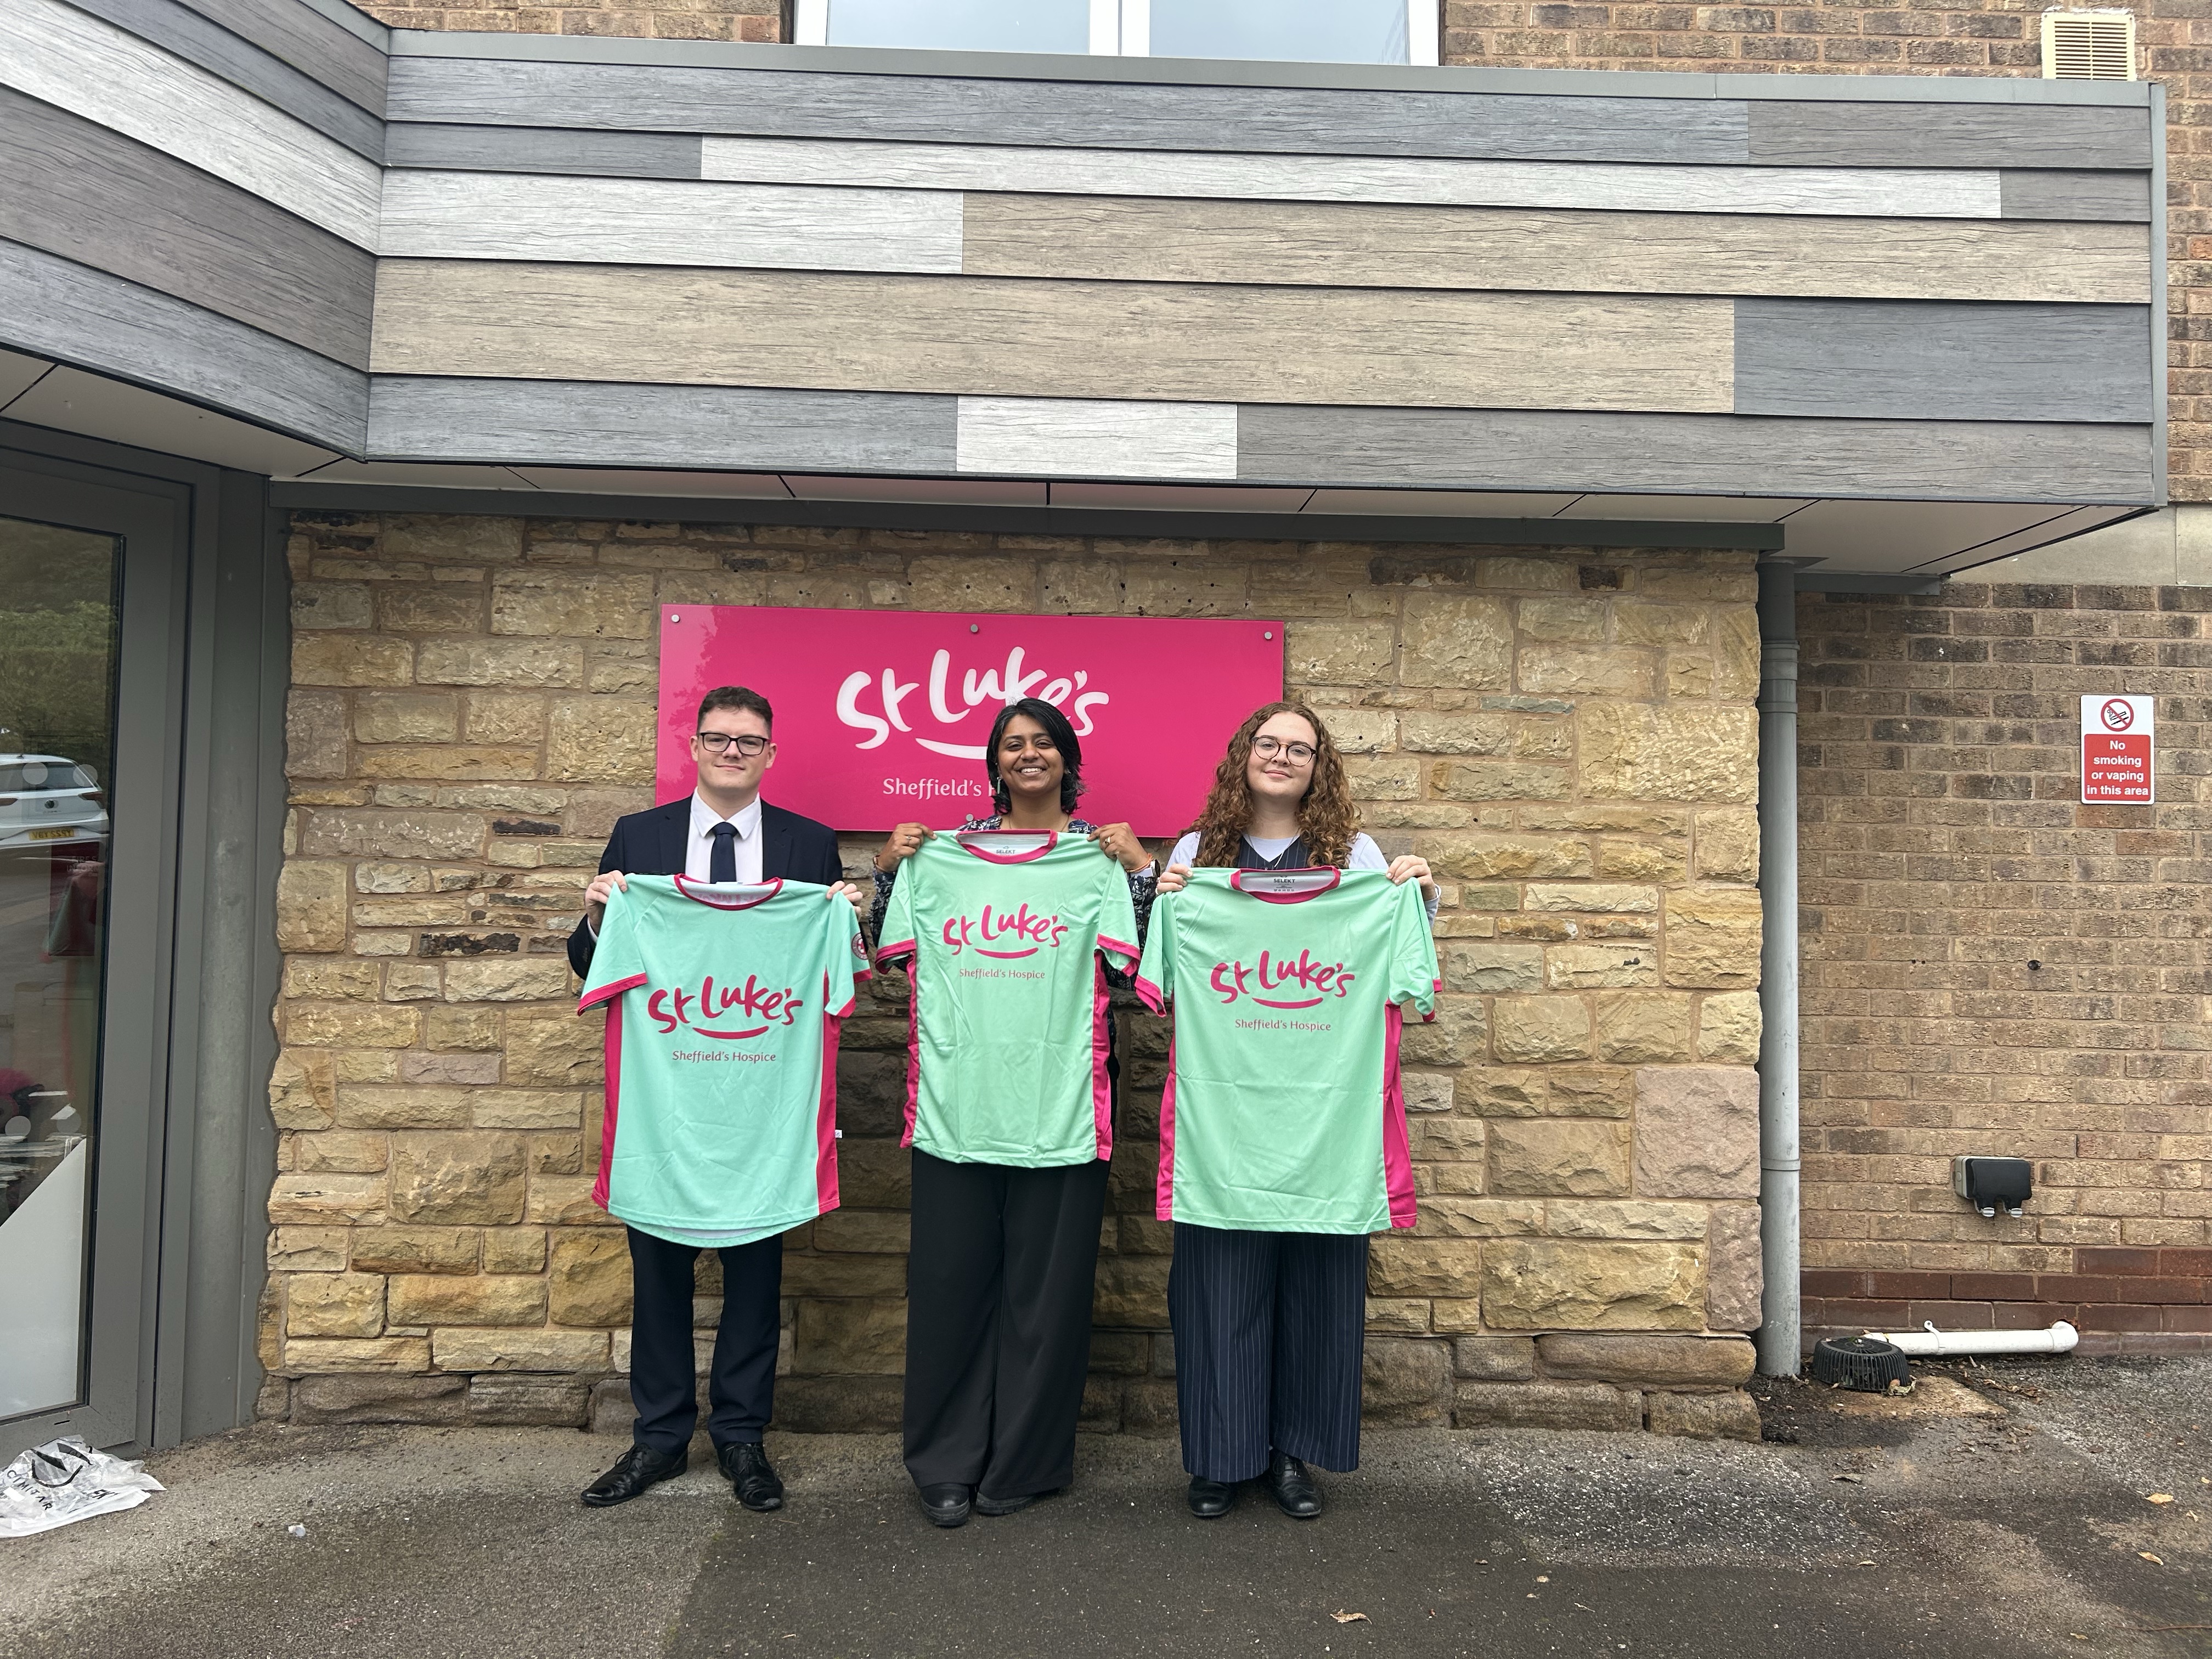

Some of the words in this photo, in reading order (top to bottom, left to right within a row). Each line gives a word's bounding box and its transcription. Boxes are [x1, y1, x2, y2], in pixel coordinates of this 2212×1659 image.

[836, 668, 920, 750] St
[929, 646, 1110, 737] Luke's
[2109, 740, 2126, 750] No
[2093, 755, 2142, 768] smoking
[2106, 770, 2144, 783] vaping
[882, 777, 982, 800] Sheffield's
[2087, 785, 2097, 794] in
[2100, 785, 2122, 795] this
[2124, 787, 2149, 795] area
[943, 916, 977, 955] St
[980, 902, 1069, 947] Luke's
[960, 968, 1006, 979] Sheffield's
[1008, 969, 1045, 980] Hospice
[1210, 961, 1254, 1004] St
[1258, 949, 1355, 998] Luke's
[647, 988, 696, 1034] St
[701, 974, 803, 1025] Luke's
[1234, 1018, 1287, 1031] Sheffield's
[1290, 1020, 1331, 1032] Hospice
[672, 1051, 729, 1063] Sheffield's
[732, 1052, 776, 1063] Hospice
